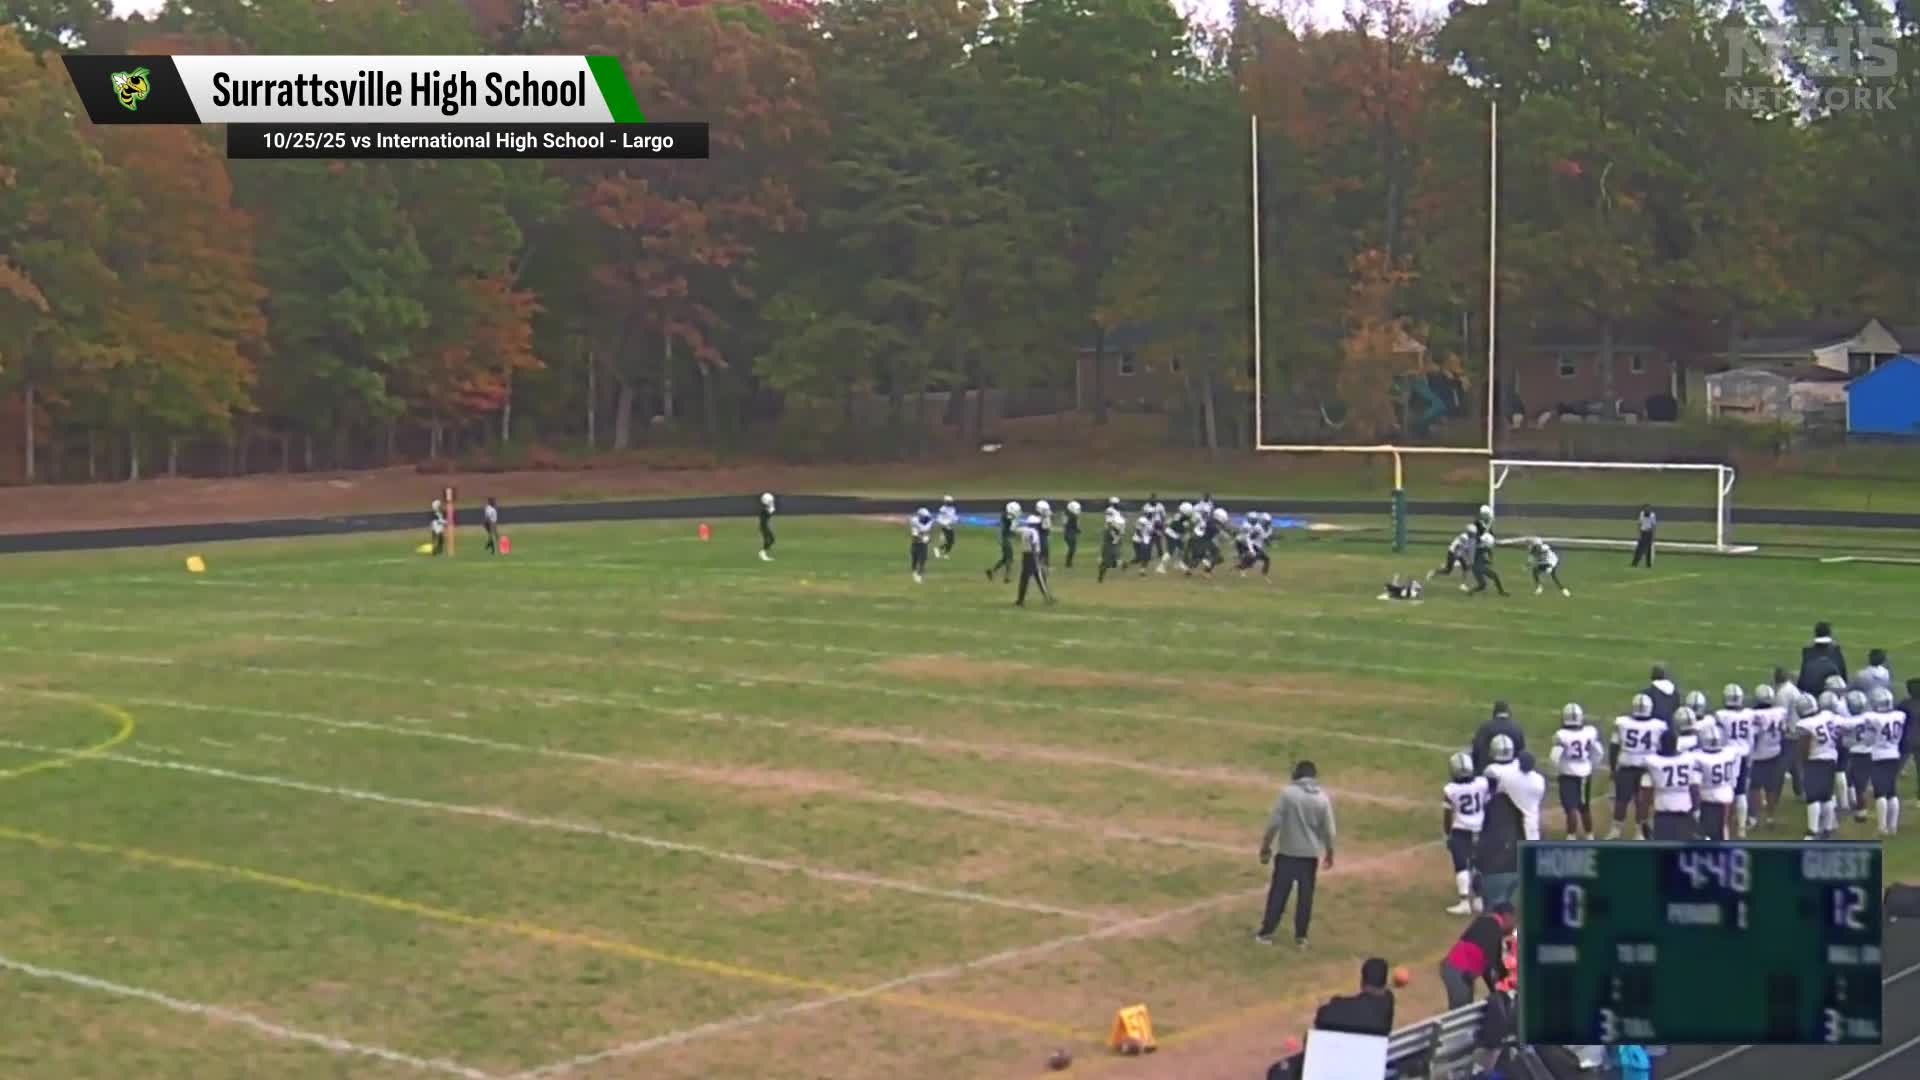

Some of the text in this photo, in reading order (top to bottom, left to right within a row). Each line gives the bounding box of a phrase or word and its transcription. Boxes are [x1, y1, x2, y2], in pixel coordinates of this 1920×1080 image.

[1625, 729, 1652, 750] 54
[1730, 720, 1749, 740] 15
[1662, 765, 1689, 788] 75
[1459, 792, 1480, 816] 21
